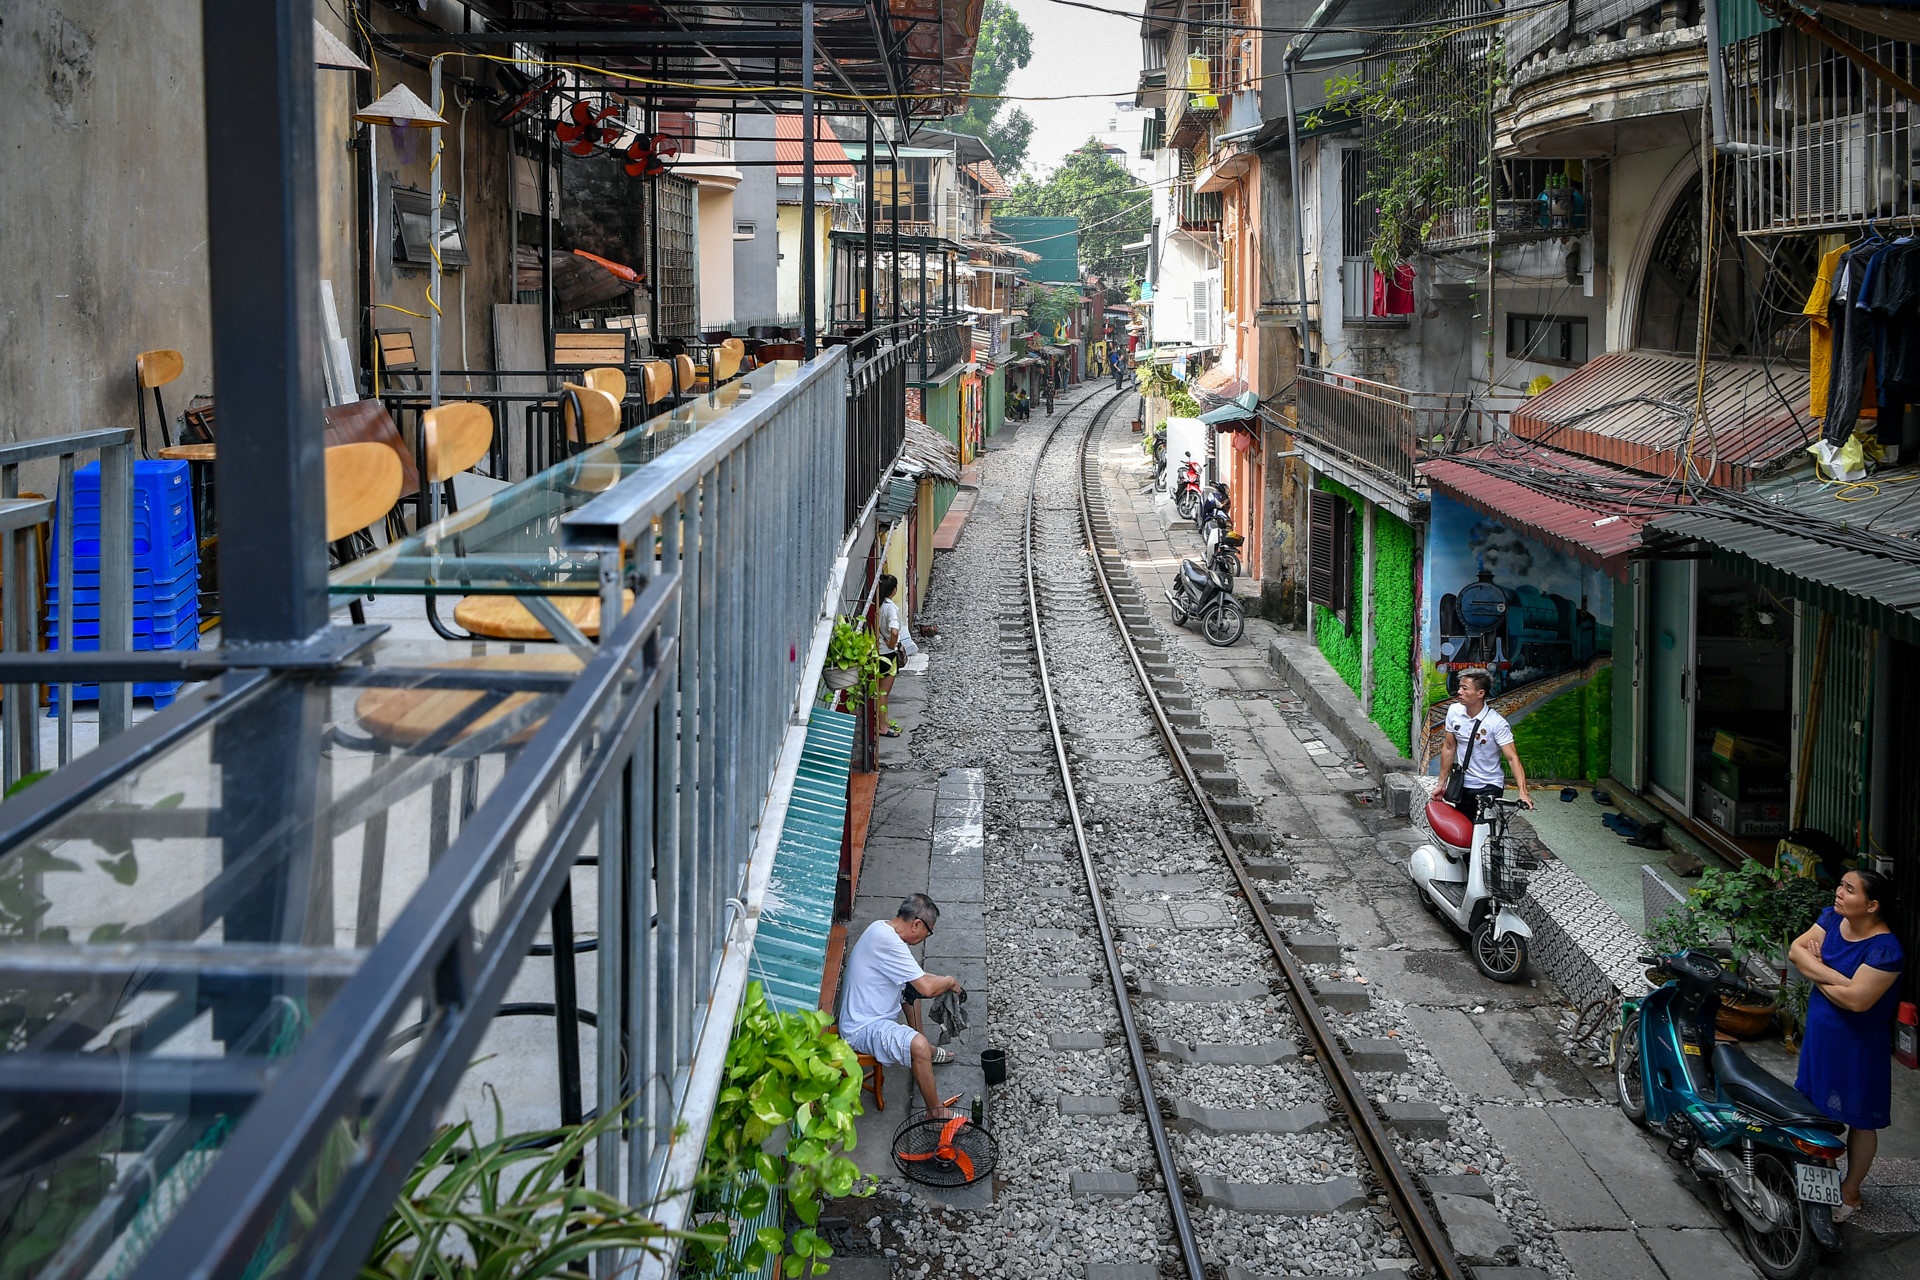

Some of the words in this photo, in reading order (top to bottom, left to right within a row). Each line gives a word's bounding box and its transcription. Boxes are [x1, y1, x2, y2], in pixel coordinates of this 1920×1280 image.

[1746, 1124, 1763, 1132] 110
[1802, 1166, 1834, 1186] 29-P1
[1800, 1183, 1839, 1204] 425.86
